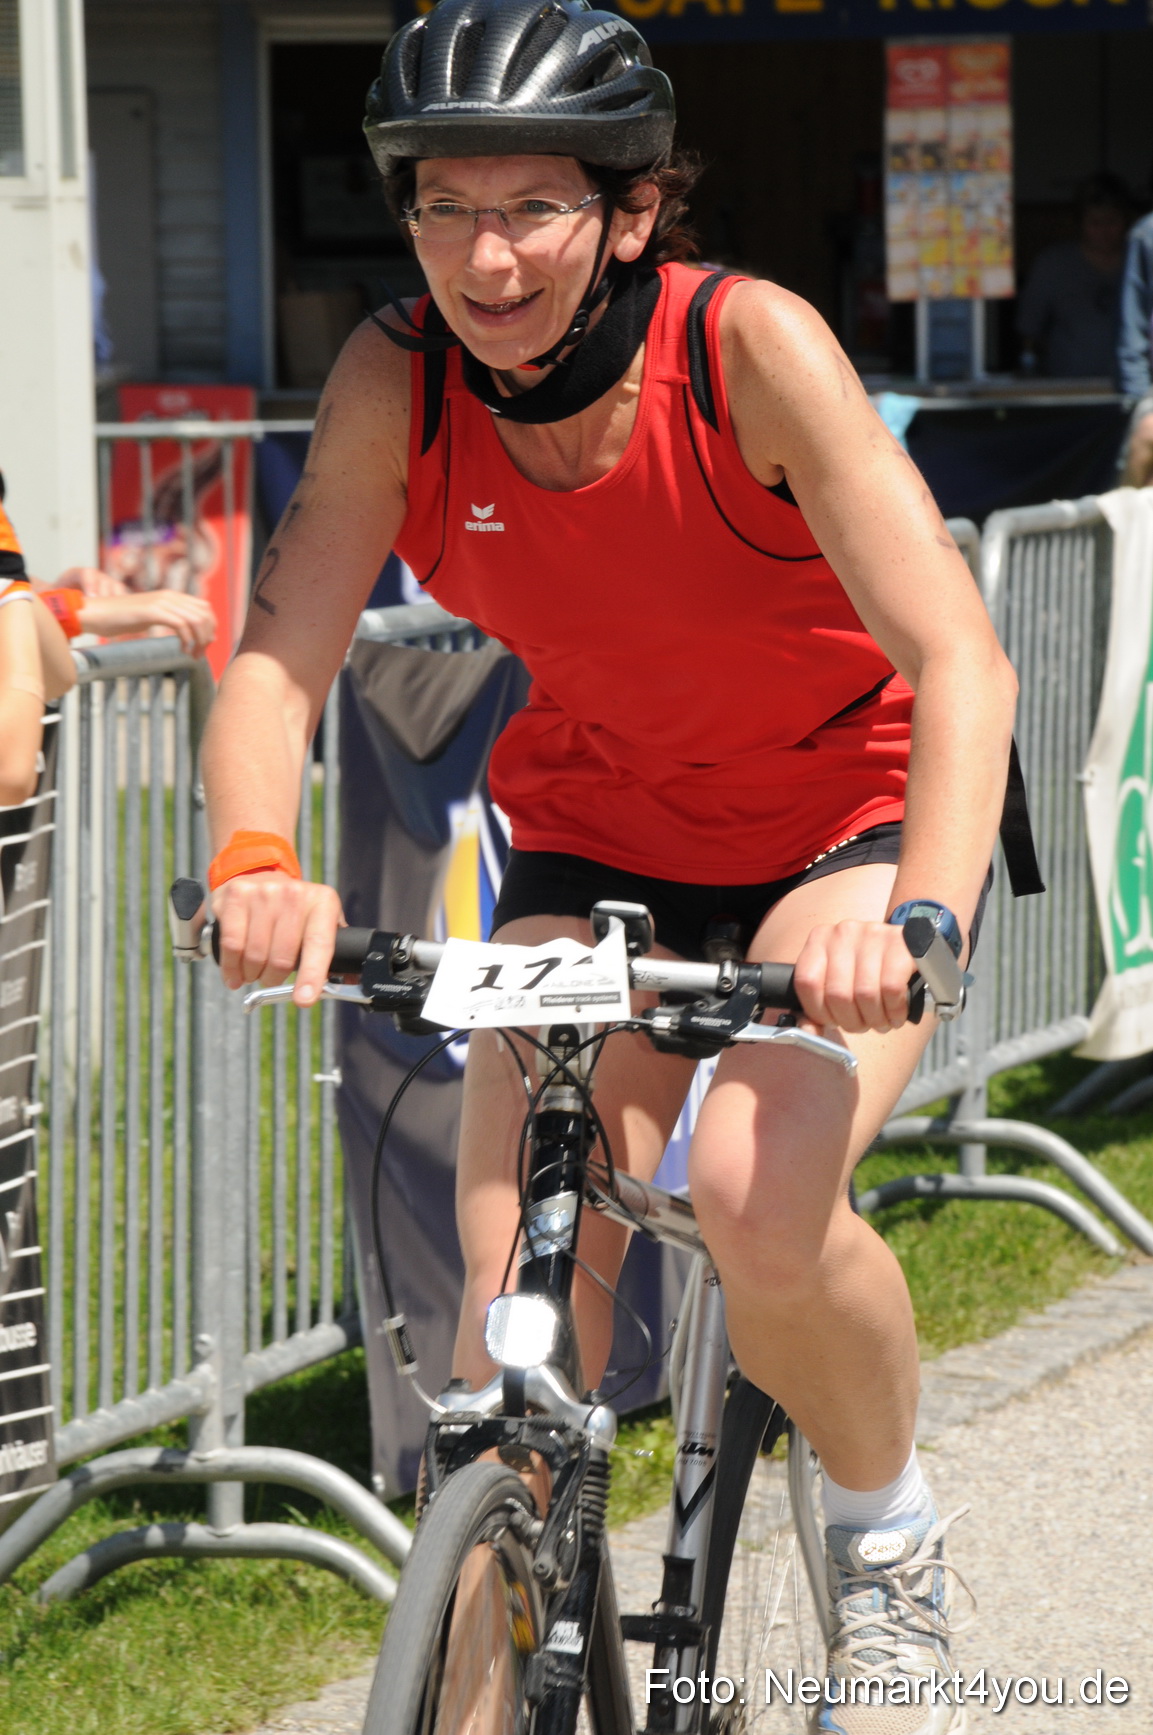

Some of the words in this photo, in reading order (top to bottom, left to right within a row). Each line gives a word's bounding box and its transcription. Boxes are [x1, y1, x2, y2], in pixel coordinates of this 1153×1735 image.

[421, 101, 500, 112] ALPINA
[464, 521, 505, 532] erima
[469, 954, 594, 993] 17
